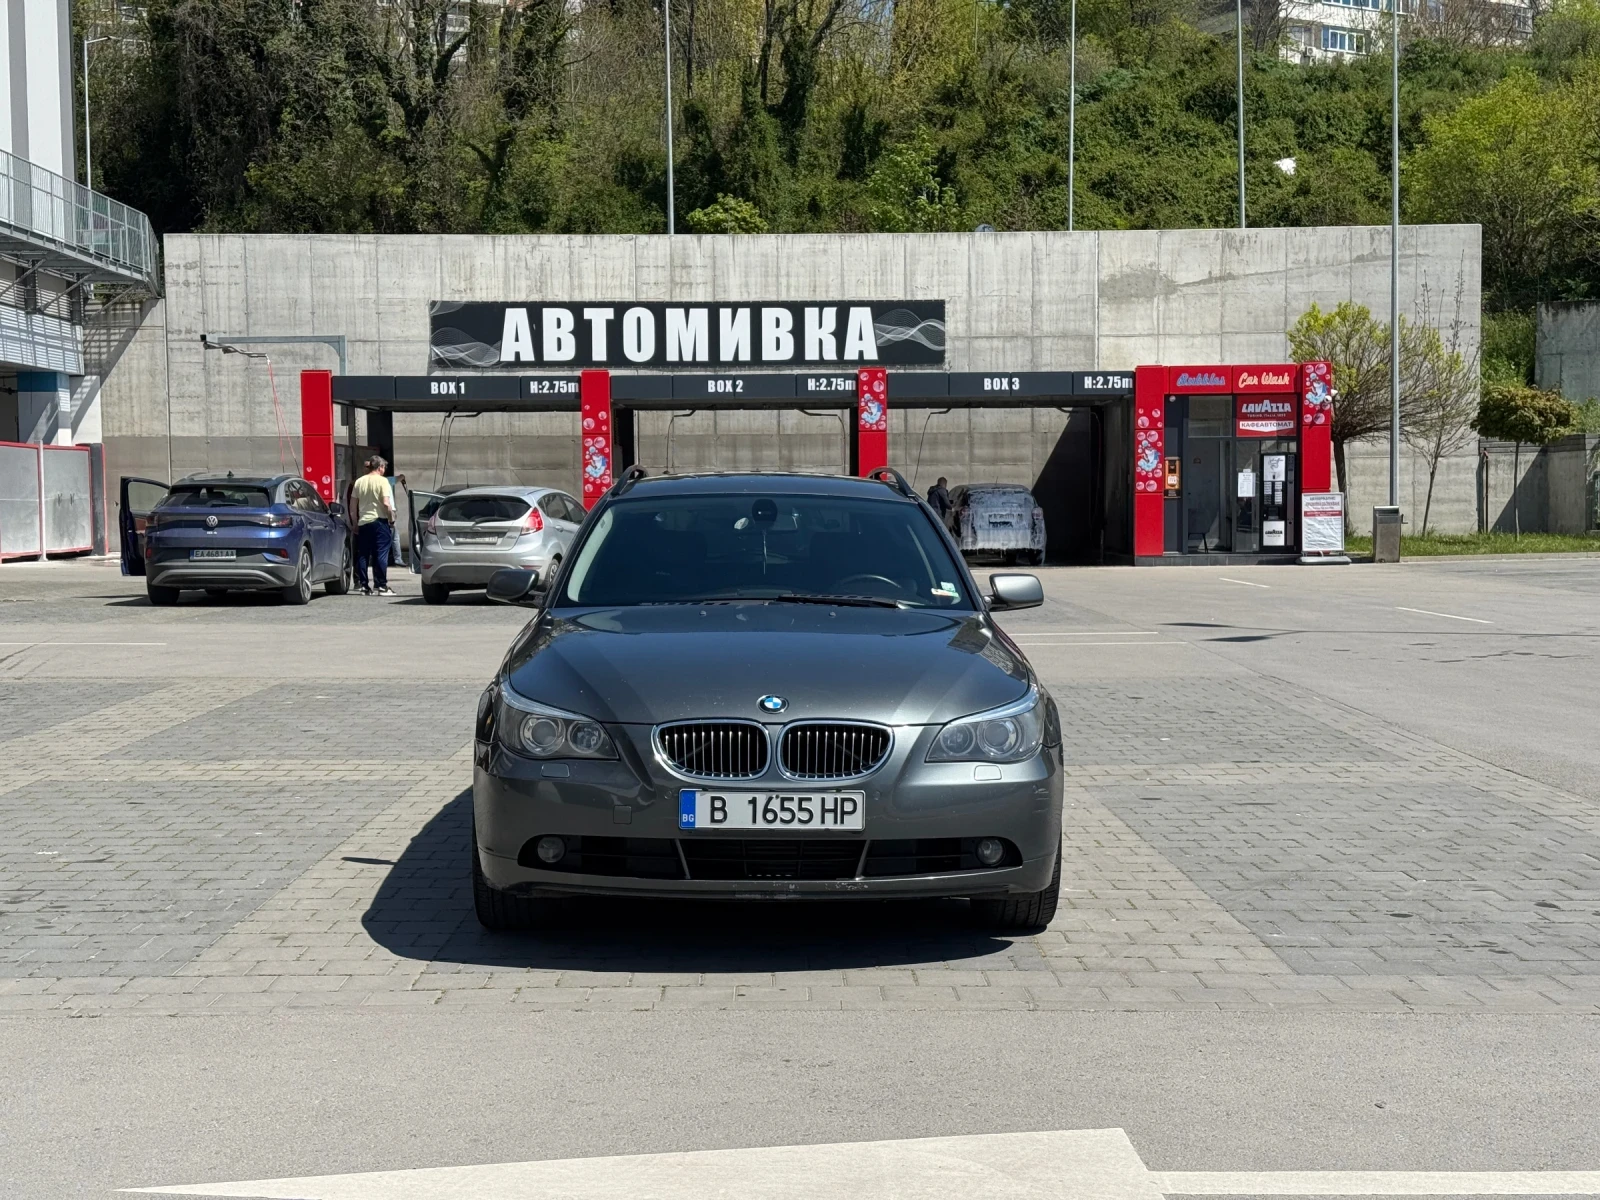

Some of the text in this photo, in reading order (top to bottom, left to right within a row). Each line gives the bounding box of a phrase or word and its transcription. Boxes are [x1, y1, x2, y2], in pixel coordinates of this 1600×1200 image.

[500, 306, 879, 363] АВТОМИВКА
[530, 380, 579, 394] H:2.75m
[707, 379, 744, 393] BOX 2
[807, 378, 856, 392] H:2.75m
[983, 377, 1020, 391] BOX 3
[1084, 375, 1133, 389] H:2.75m
[1238, 372, 1290, 388] Car Wash
[430, 381, 465, 395] BOX 1
[1241, 399, 1292, 413] LAVAZZA
[710, 795, 728, 824] B
[748, 795, 814, 825] 1655
[682, 813, 695, 823] BG
